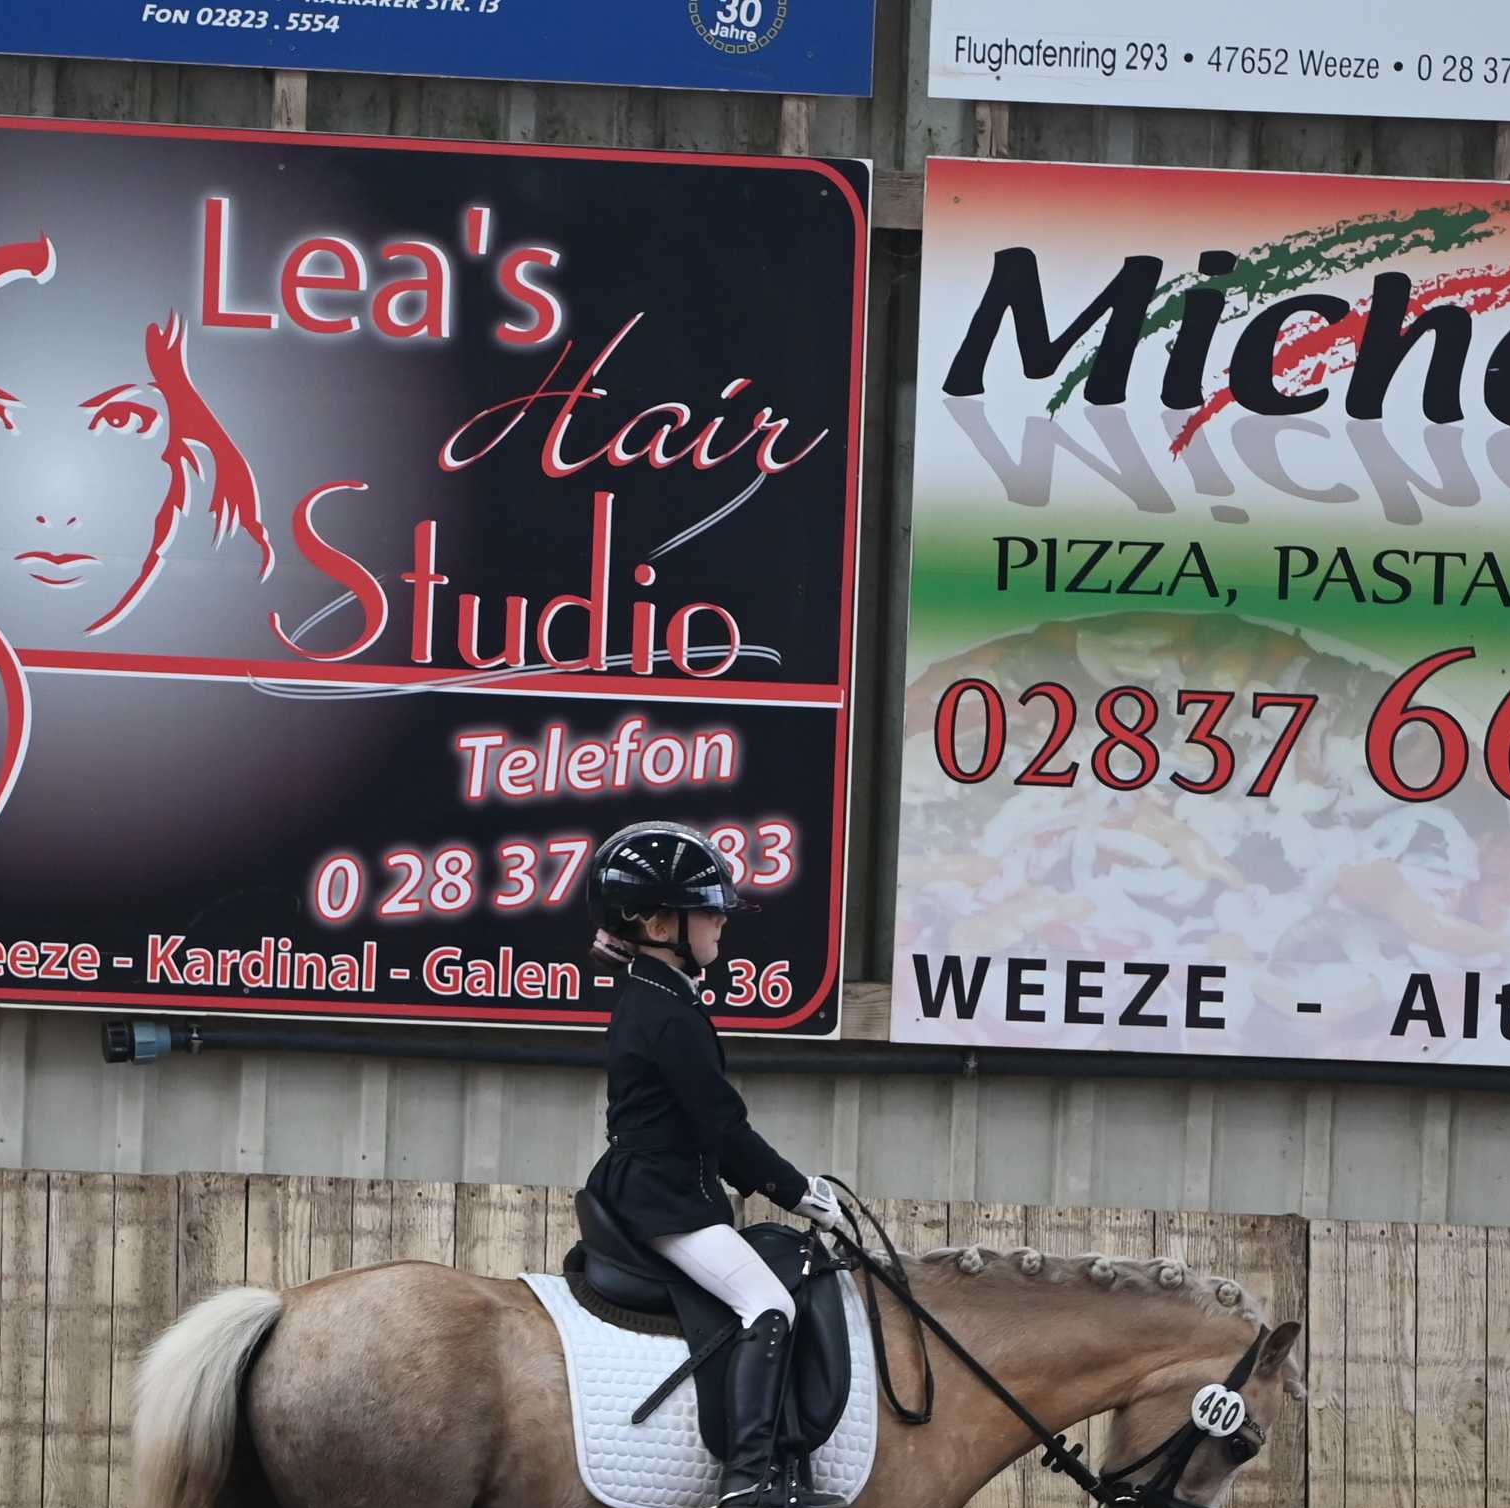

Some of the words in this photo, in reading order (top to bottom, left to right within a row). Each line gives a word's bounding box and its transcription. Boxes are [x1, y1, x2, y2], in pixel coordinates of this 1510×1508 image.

[195, 7, 268, 30] 02823
[286, 13, 340, 34] 5554
[709, 22, 757, 43] Jahre
[716, 0, 763, 28] 30
[954, 35, 1117, 77] Flughafenring
[1124, 41, 1169, 72] 293
[1206, 46, 1290, 76] 47652
[1298, 48, 1380, 80] Weeze
[1416, 53, 1433, 82] 0
[1441, 54, 1474, 83] 28
[200, 196, 564, 346] Lea's
[437, 311, 831, 480] Hair
[268, 478, 743, 679] Studio
[991, 533, 1239, 606] PIZZA,
[456, 717, 737, 804] Telefon
[933, 675, 1320, 798] 02837
[315, 854, 362, 923] 0
[379, 846, 476, 919] 28
[494, 836, 590, 910] 37
[146, 933, 379, 996] Kardinal
[422, 944, 581, 1001] Galen
[724, 957, 794, 1009] 36
[911, 951, 1229, 1032] WEEZE
[1198, 1391, 1240, 1430] 460
